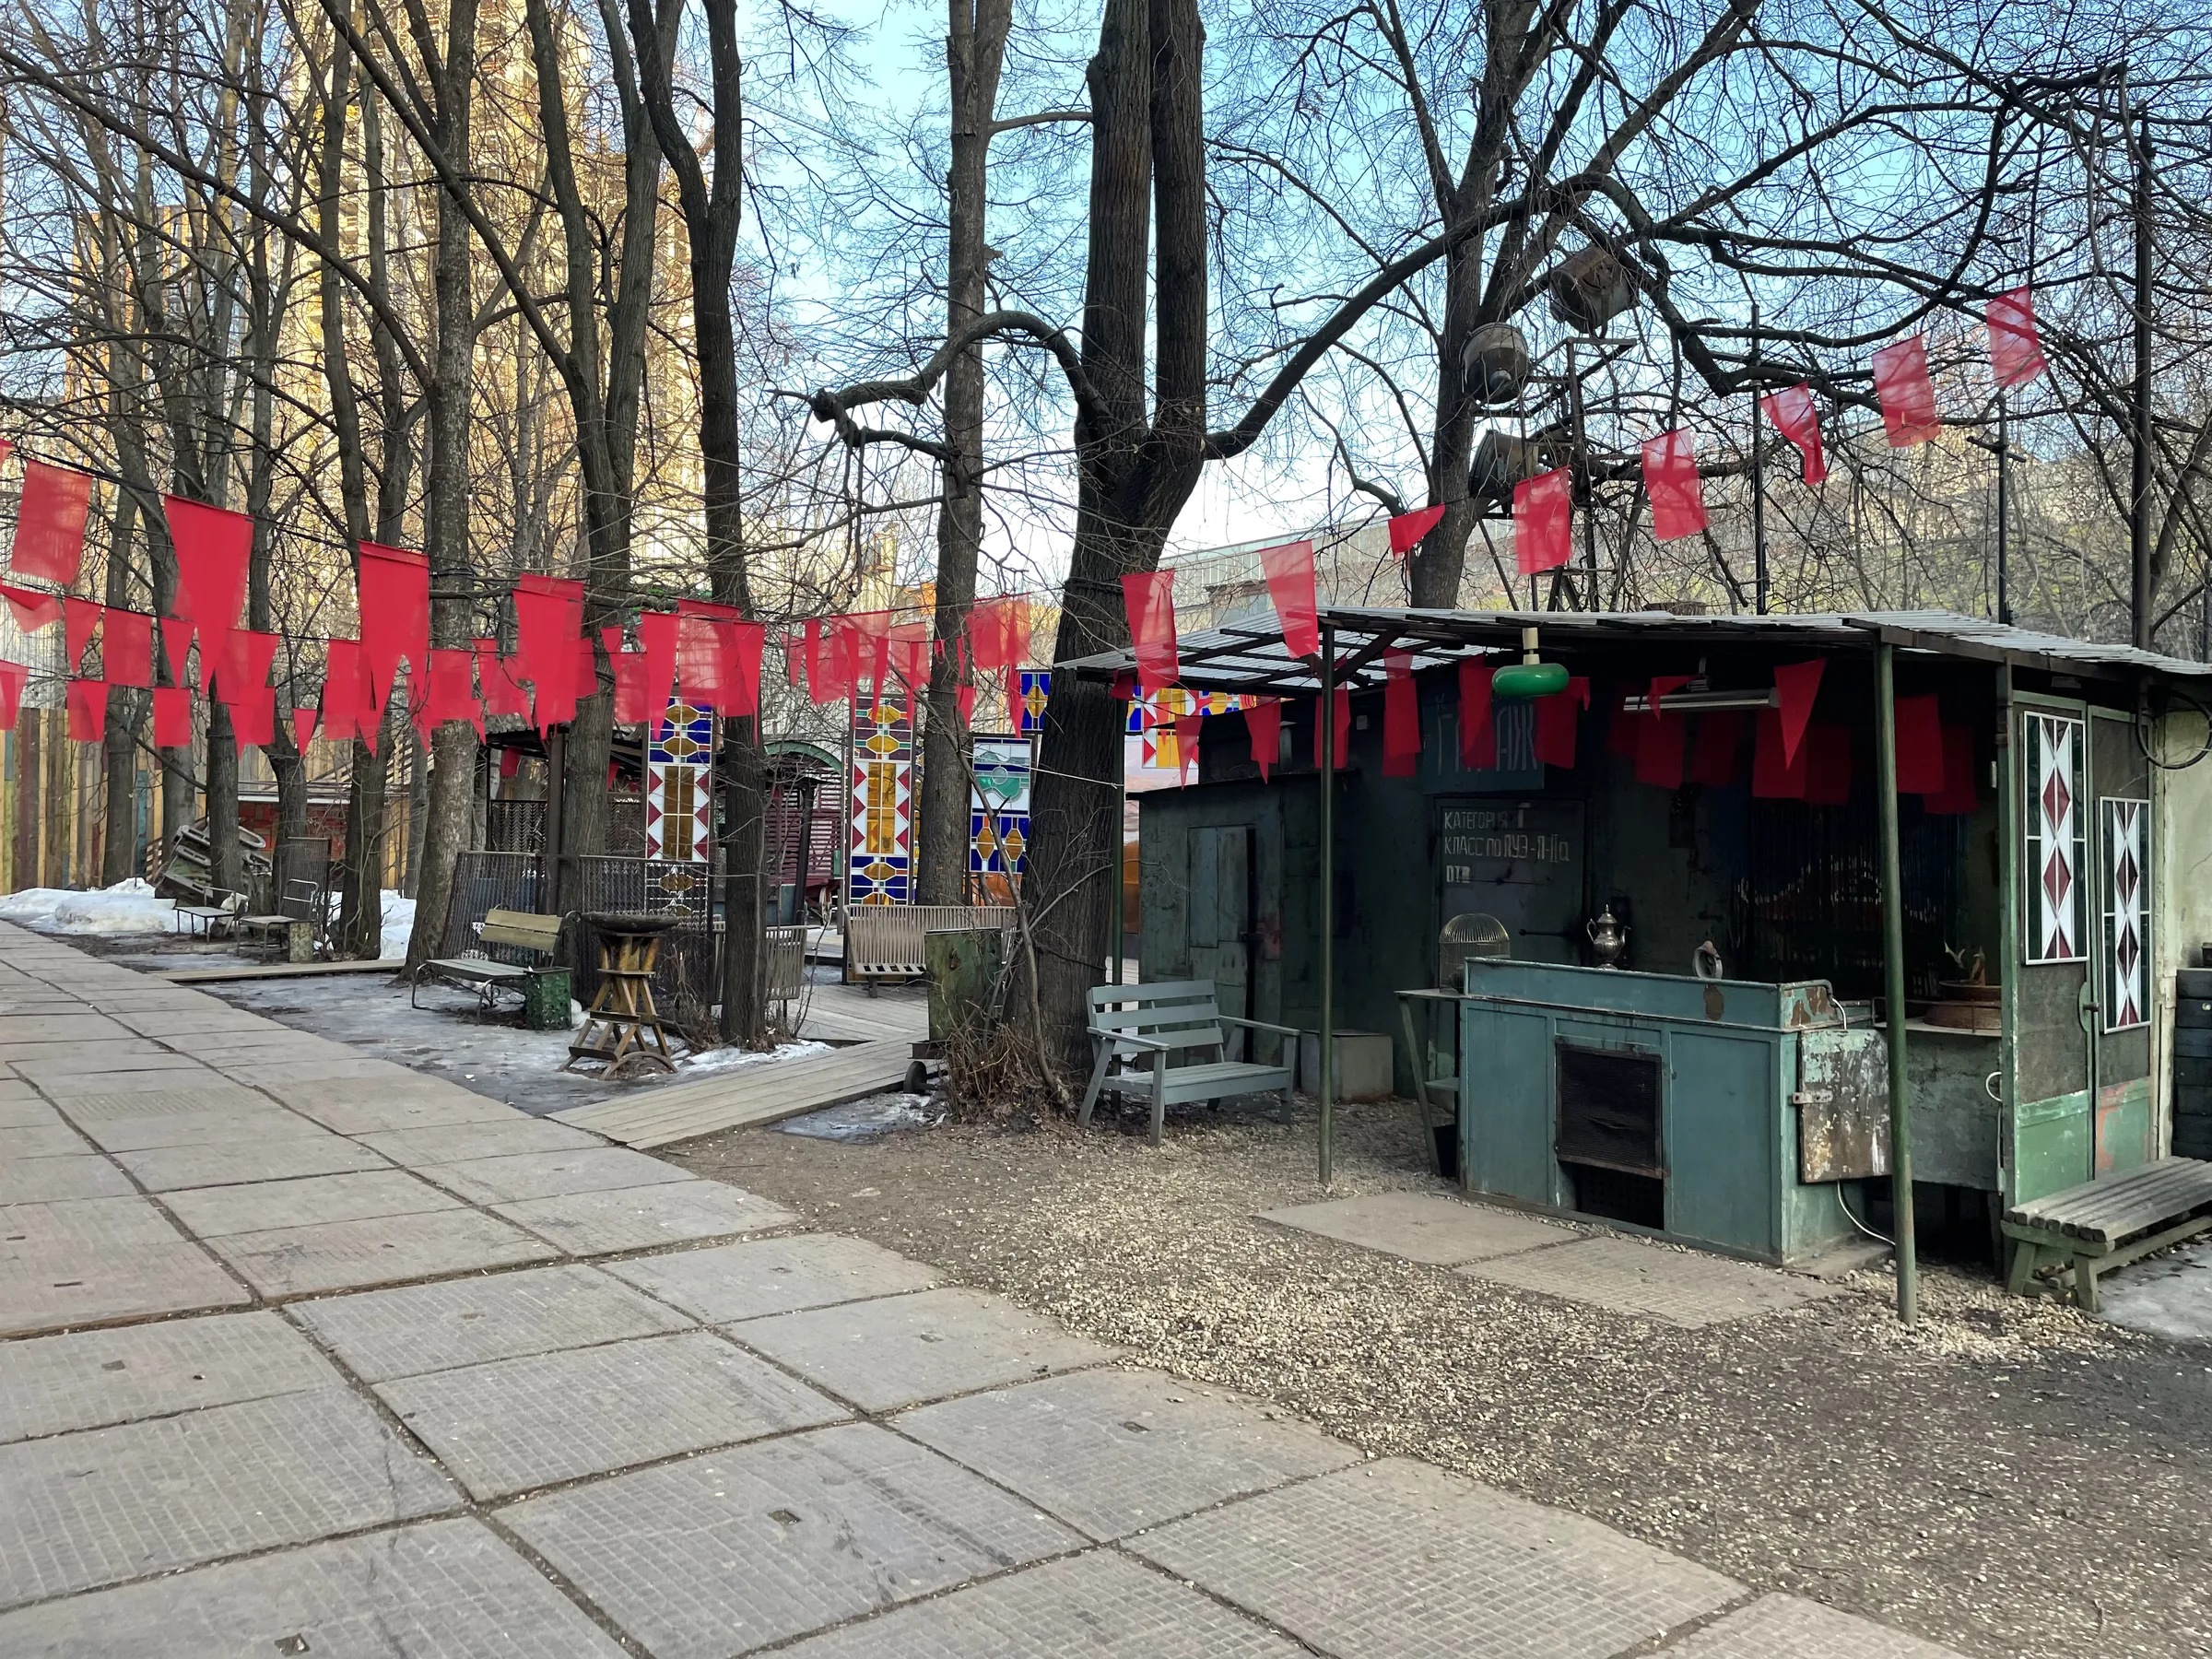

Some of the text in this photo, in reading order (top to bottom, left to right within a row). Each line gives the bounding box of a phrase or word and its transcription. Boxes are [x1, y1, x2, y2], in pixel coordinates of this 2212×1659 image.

[1438, 704, 1538, 775] ГАЖ
[1444, 811, 1508, 830] КАТЕГОРИЯ
[1444, 836, 1483, 856] КЛАСС
